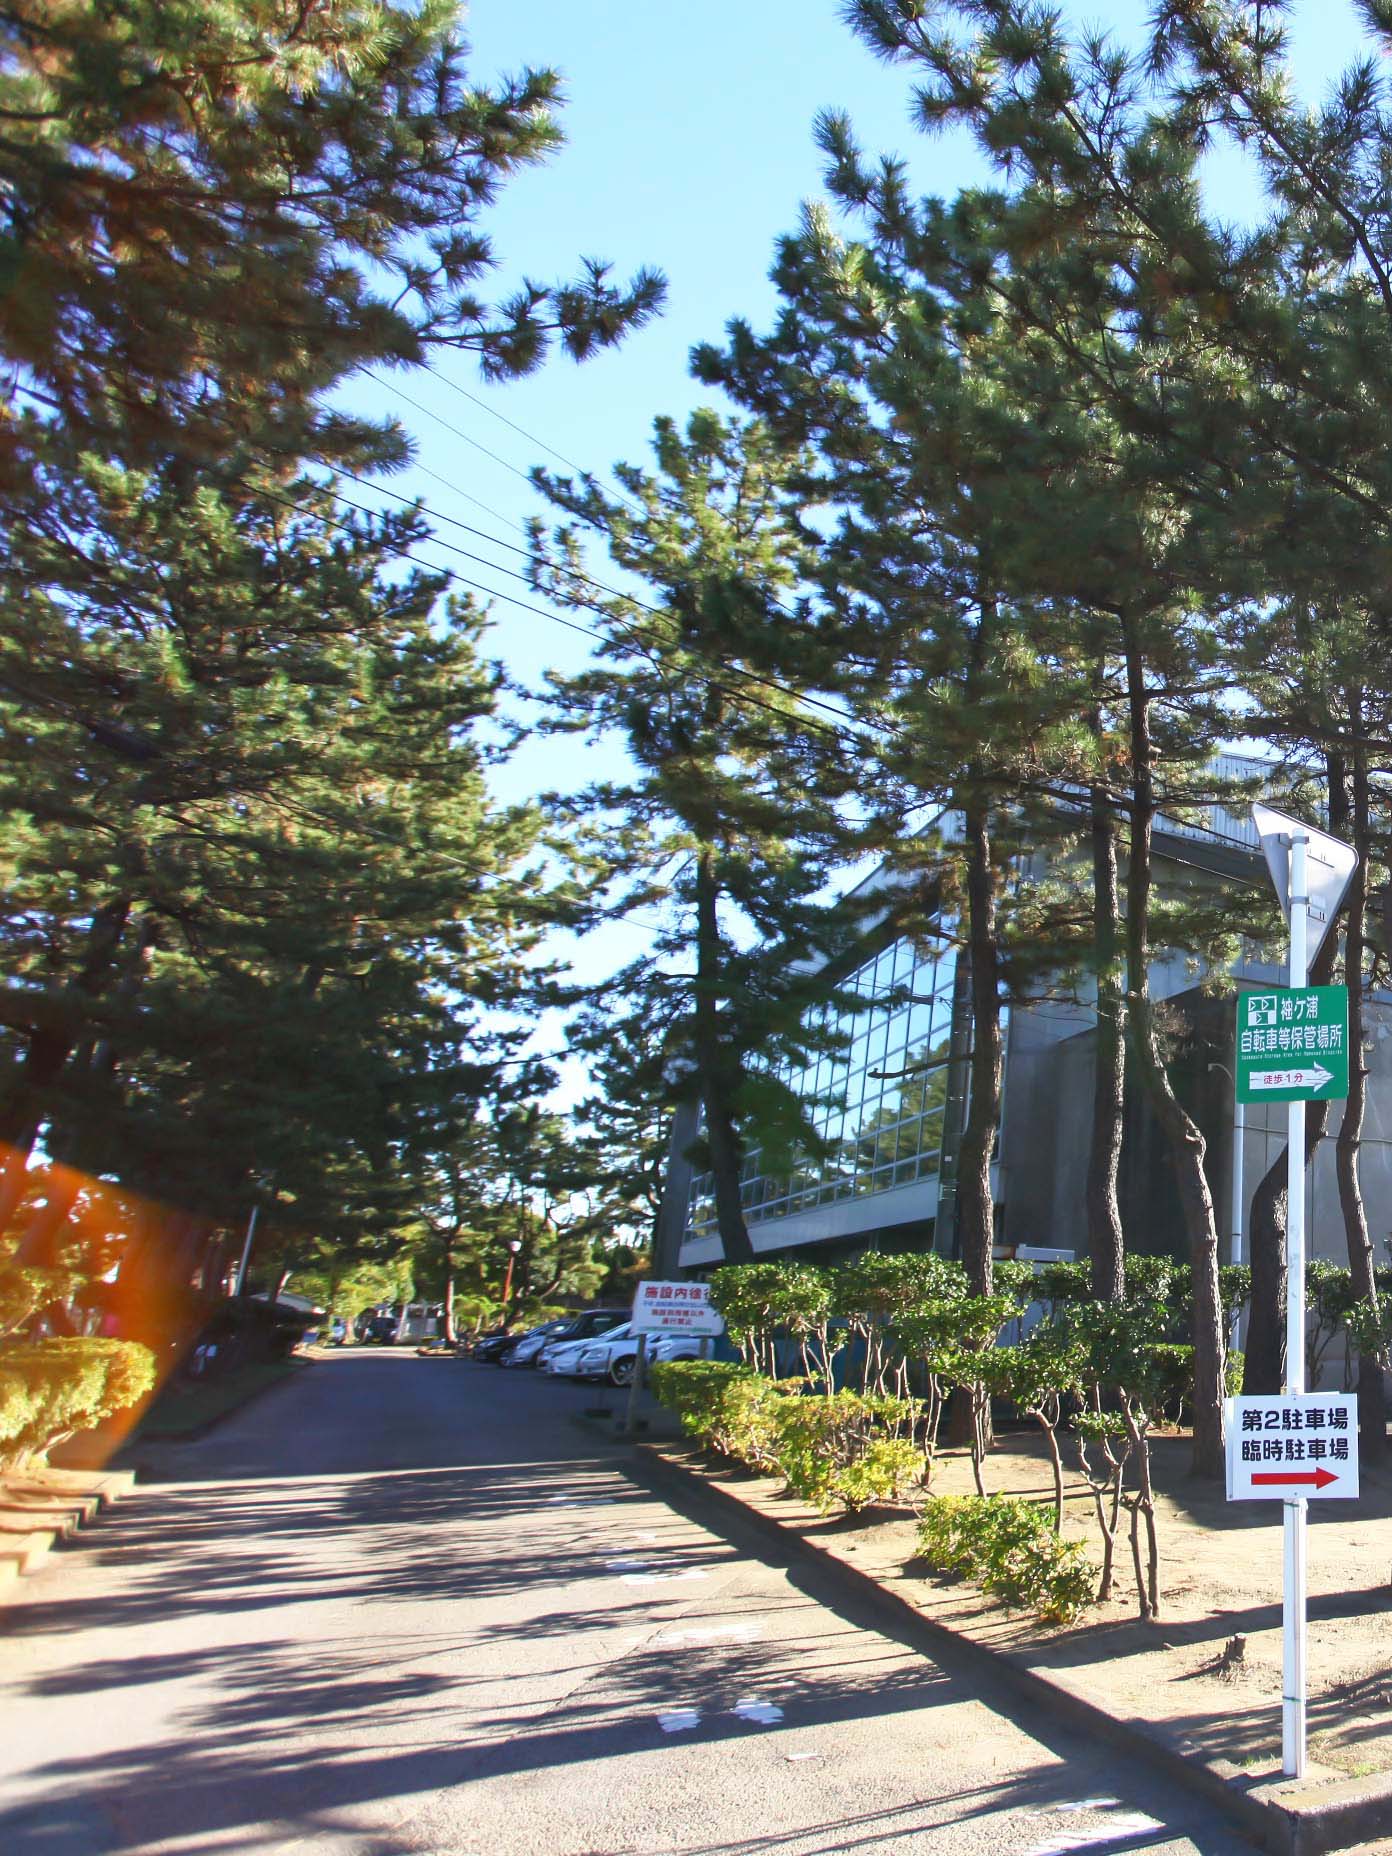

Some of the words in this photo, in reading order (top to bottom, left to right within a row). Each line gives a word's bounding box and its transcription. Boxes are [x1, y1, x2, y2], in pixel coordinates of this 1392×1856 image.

[1241, 1024, 1343, 1053] 自転車等保管場所
[1263, 1073, 1304, 1085] 徒歩1分
[1241, 1407, 1349, 1432] 第2駐車場
[1241, 1438, 1349, 1462] 臨時駐車場
